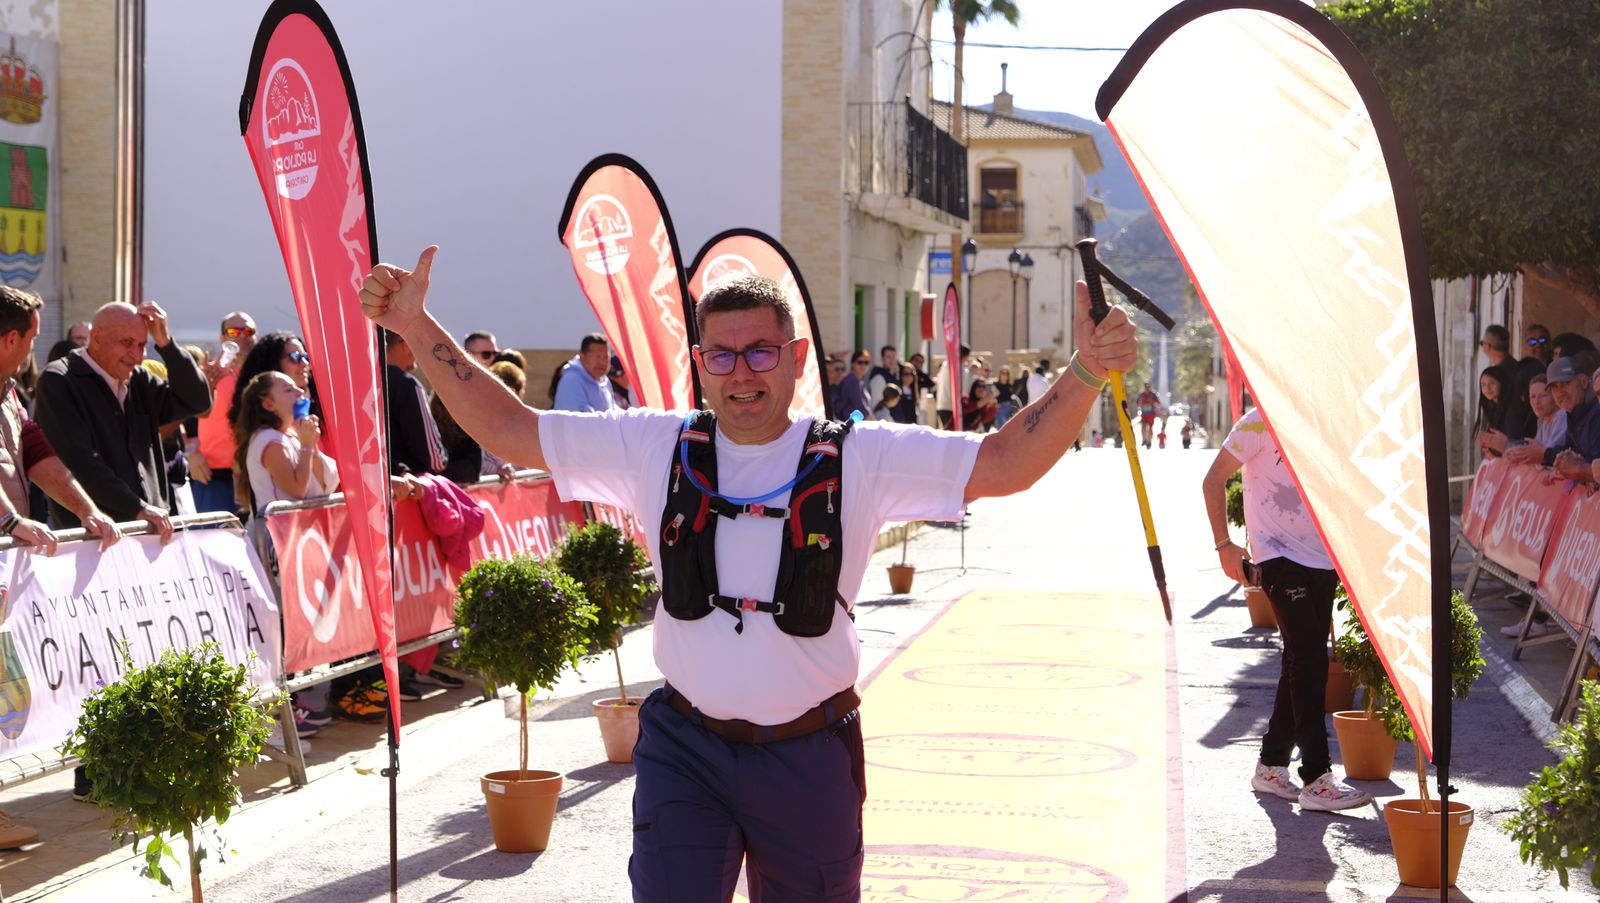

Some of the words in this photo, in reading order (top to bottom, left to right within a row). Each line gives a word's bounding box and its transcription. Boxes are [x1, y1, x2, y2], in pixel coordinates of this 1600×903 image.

[32, 574, 215, 625] AYUNTAMIENTO
[226, 569, 252, 593] DE
[41, 601, 266, 691] CANTORIA
